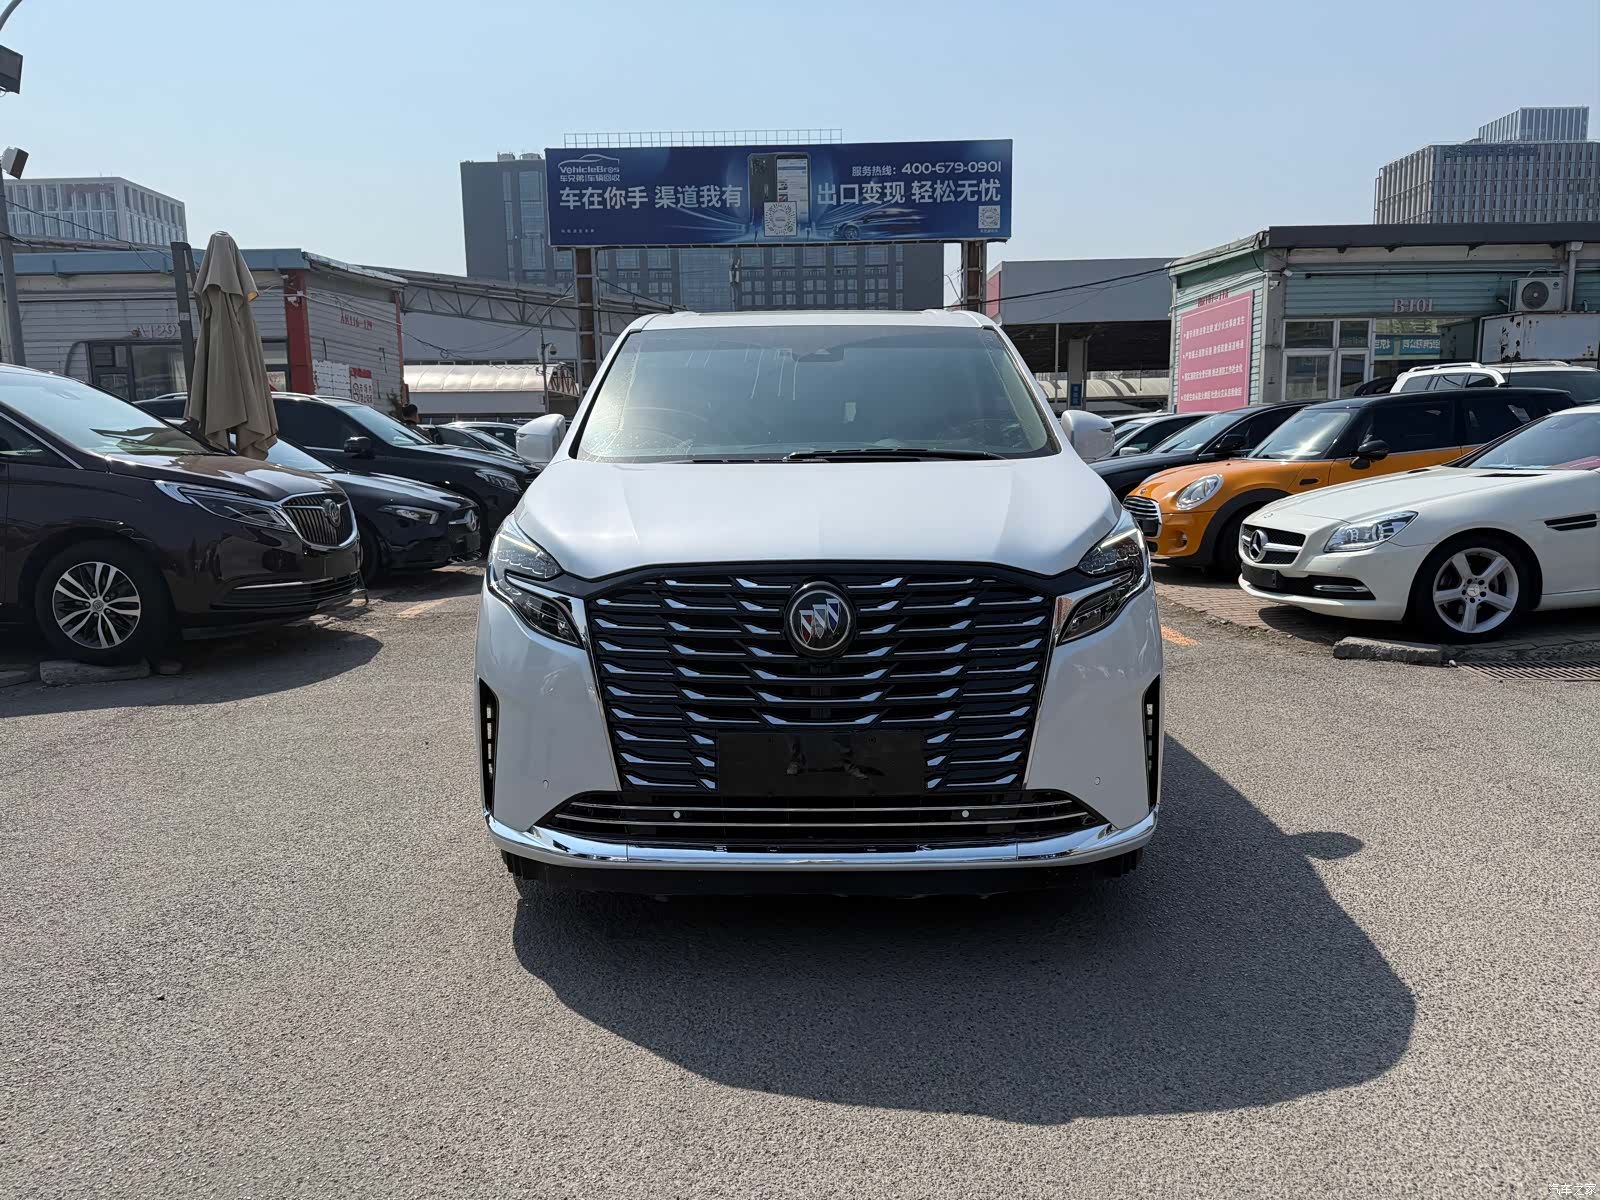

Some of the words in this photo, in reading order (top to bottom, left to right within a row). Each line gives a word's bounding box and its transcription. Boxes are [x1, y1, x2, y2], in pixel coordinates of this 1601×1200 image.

[901, 161, 1001, 174] 400-679-0901
[560, 186, 648, 210] 车在你手
[654, 184, 743, 209] 渠道我有
[817, 181, 905, 206] 出口变现
[911, 178, 1001, 204] 轻松无忧
